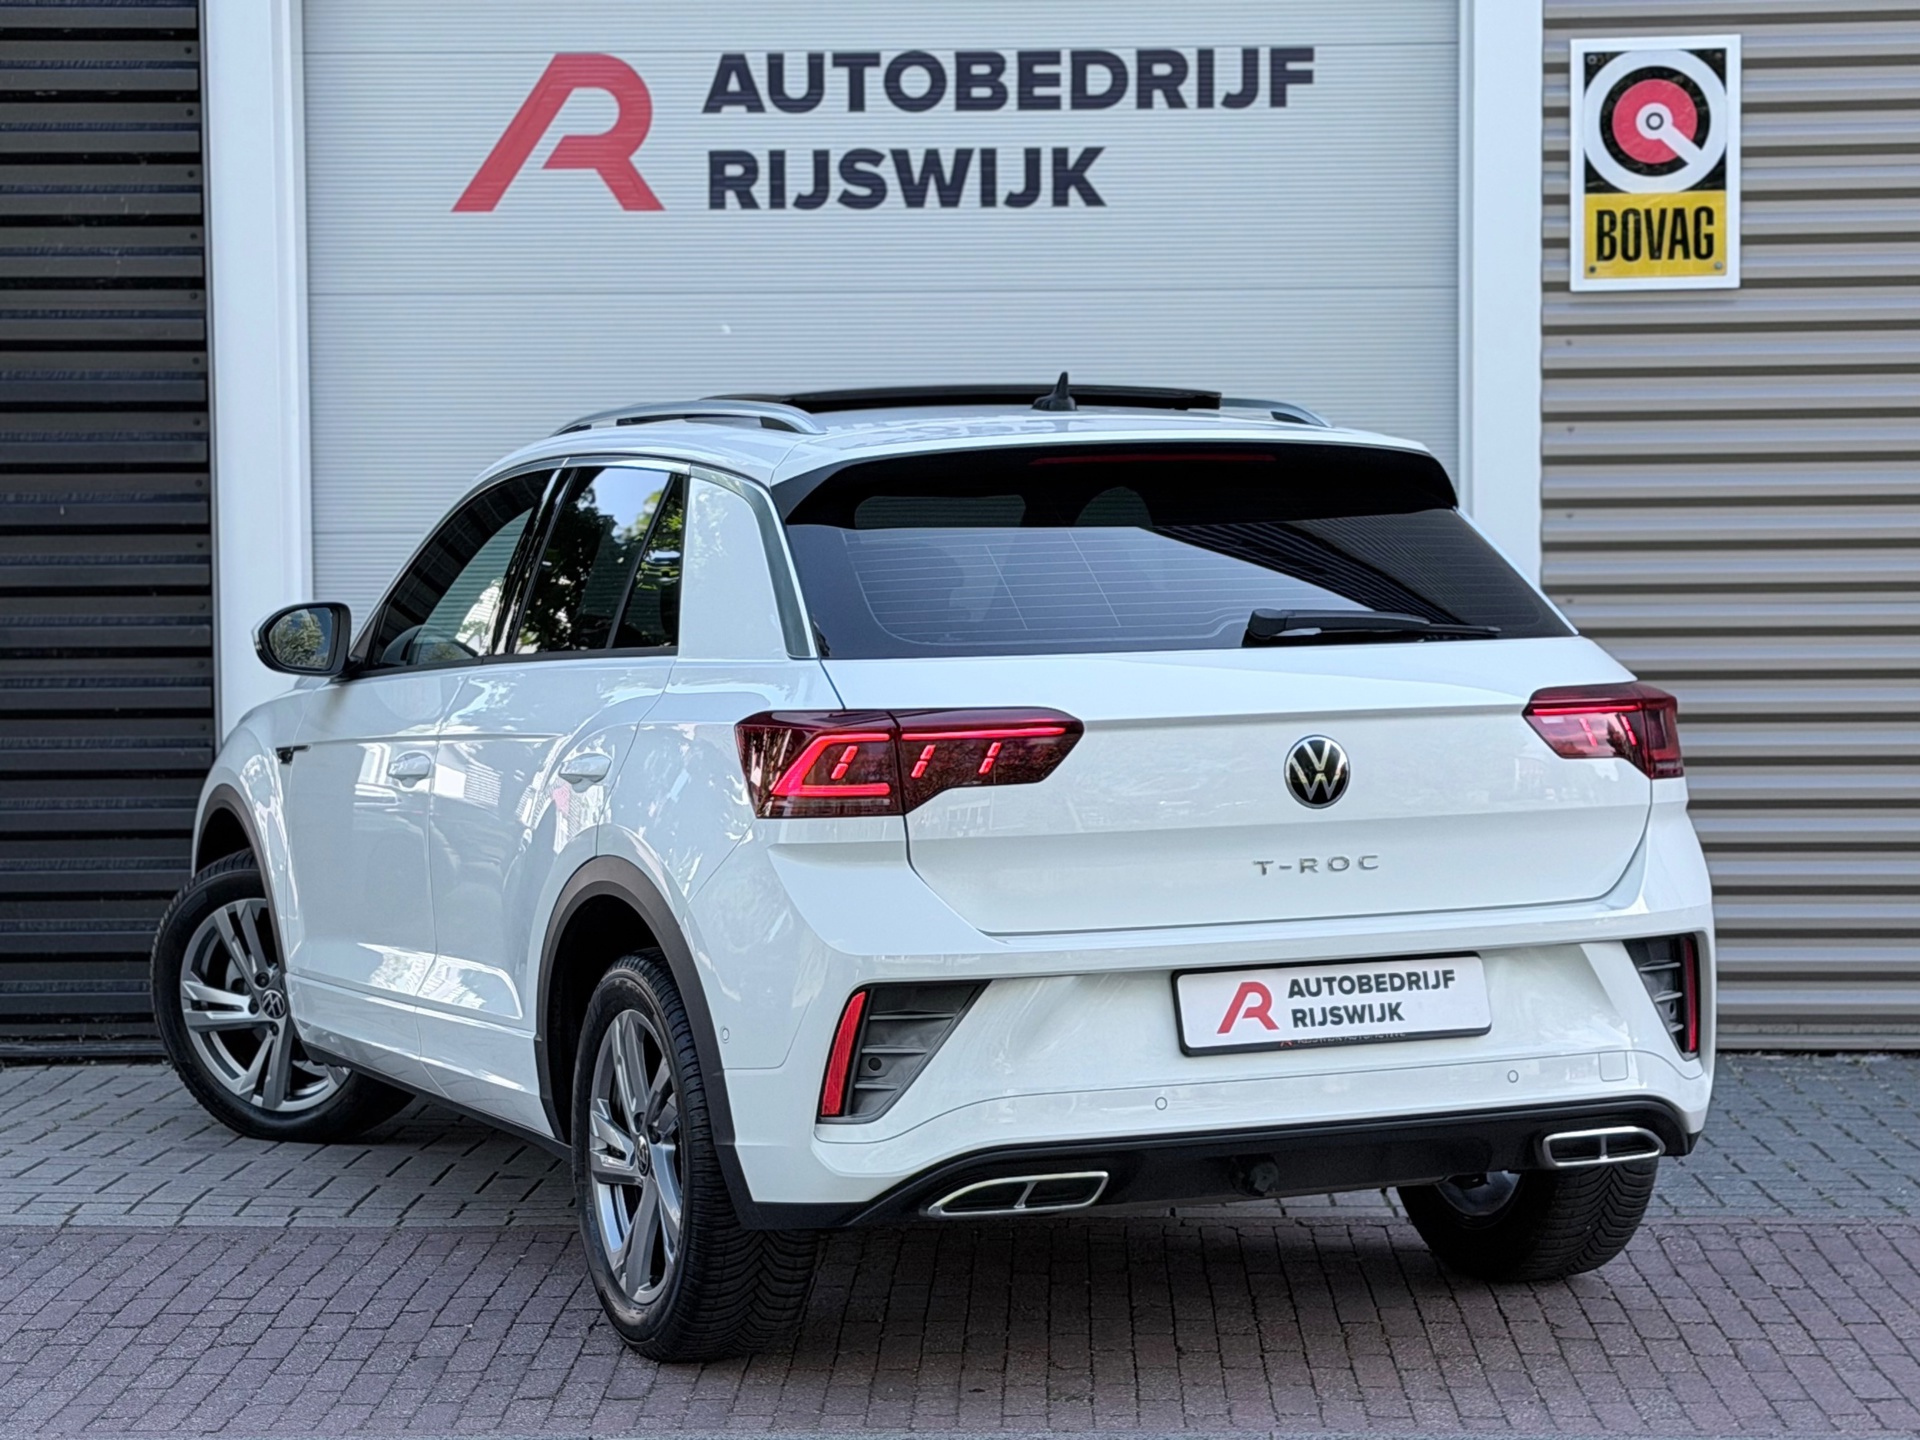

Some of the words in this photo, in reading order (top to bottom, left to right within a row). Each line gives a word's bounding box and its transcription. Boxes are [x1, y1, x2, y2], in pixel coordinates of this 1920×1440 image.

[702, 46, 1315, 114] AUTOBEDRIJF
[707, 147, 1107, 211] RIJSWIJK
[1595, 205, 1715, 263] BOVAG
[1253, 854, 1380, 876] T-ROC
[1287, 968, 1456, 999] AUTOBEDRIJF
[1291, 1001, 1405, 1028] RIJSWIJK
